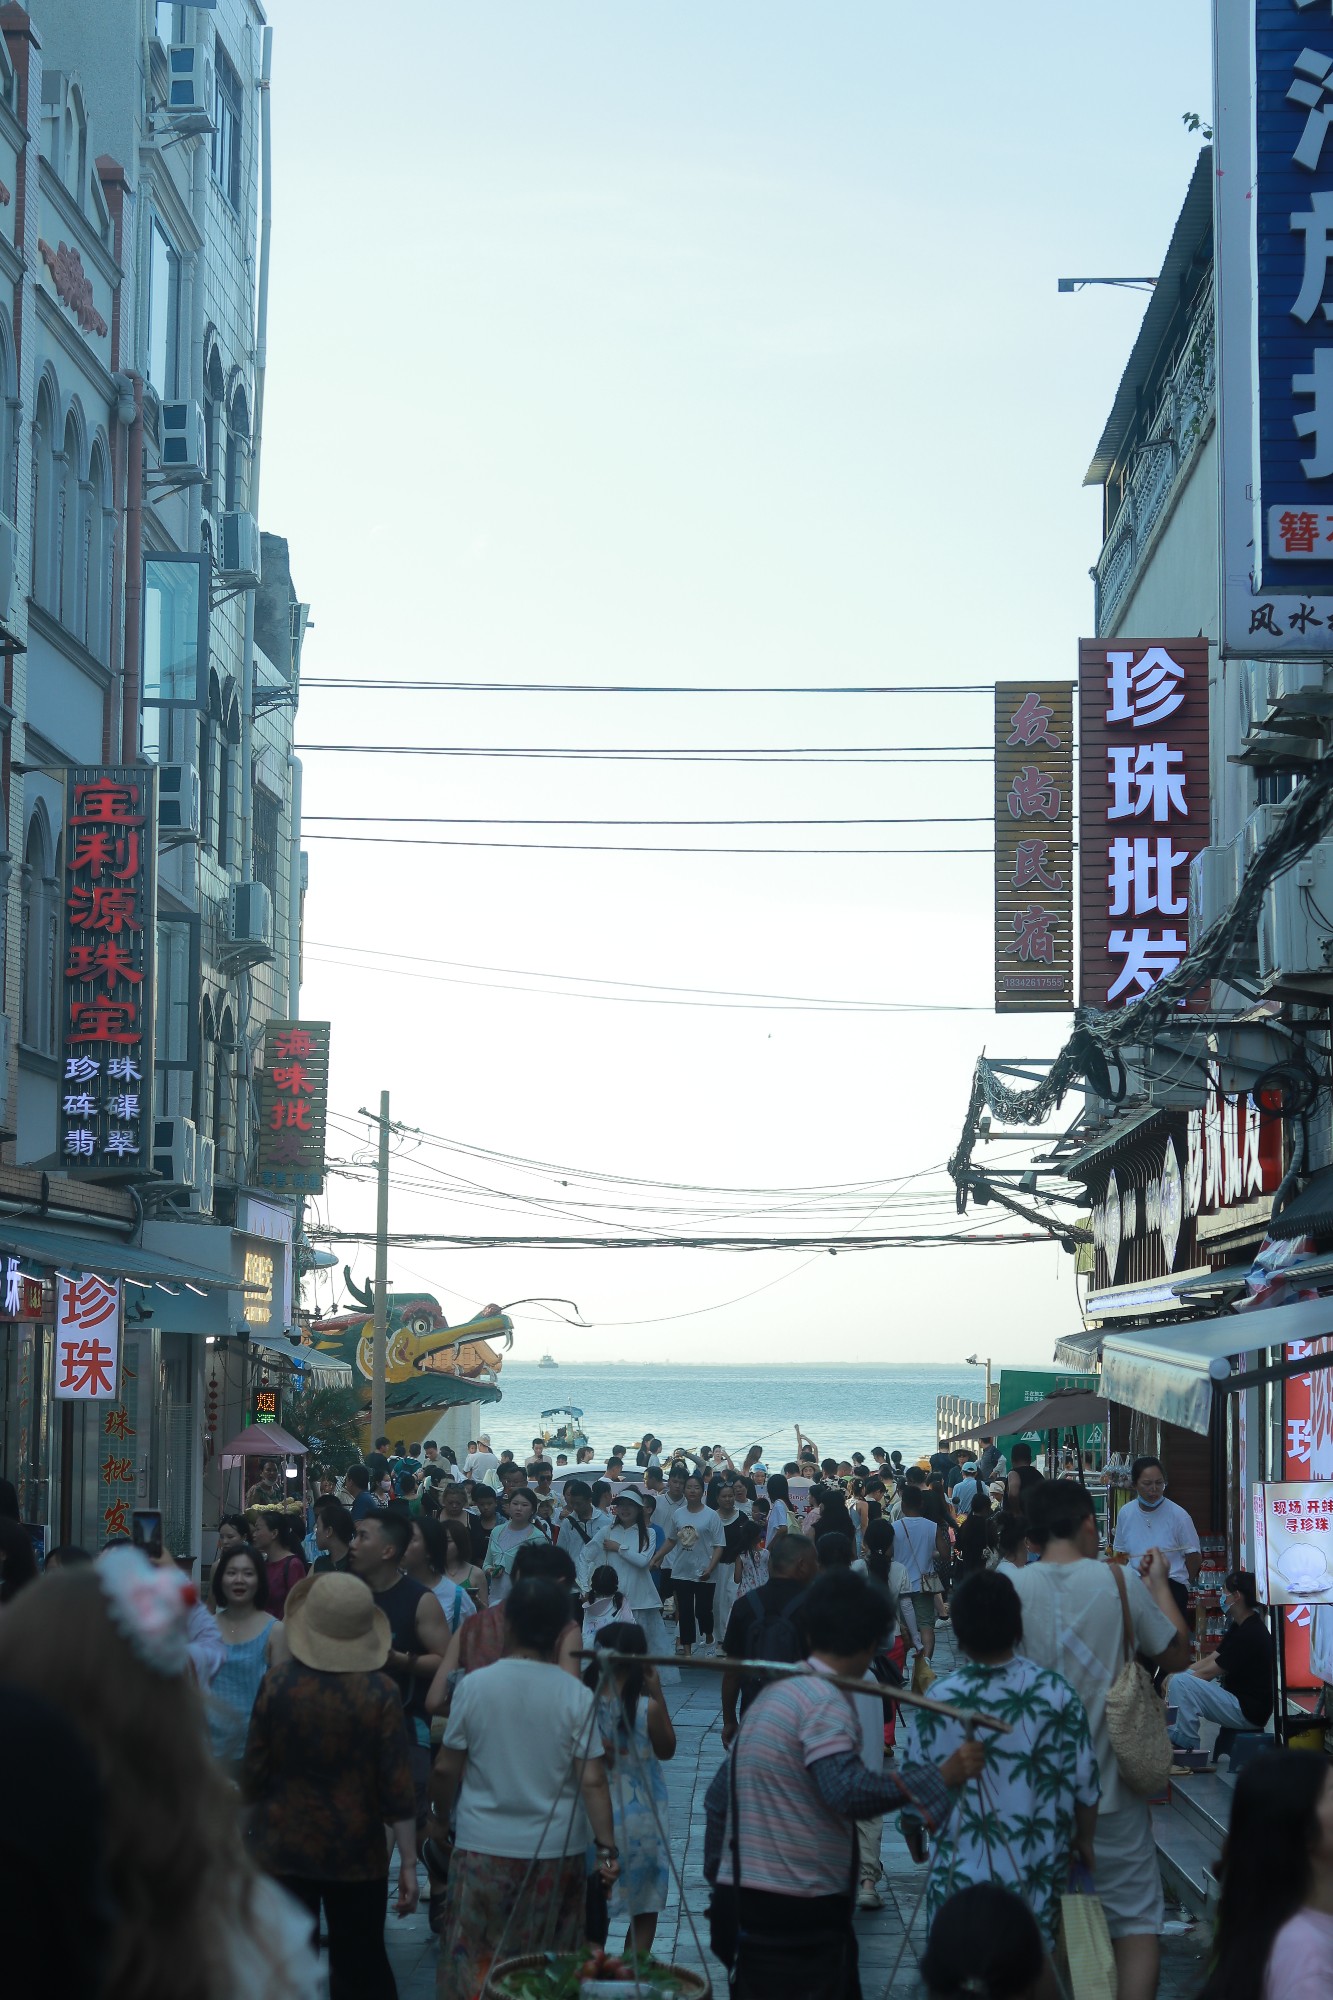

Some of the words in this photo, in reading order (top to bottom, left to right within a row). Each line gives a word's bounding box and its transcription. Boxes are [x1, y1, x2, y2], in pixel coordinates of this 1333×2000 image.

[1279, 511, 1333, 553] 簪
[1248, 602, 1333, 637] 风水
[1105, 647, 1188, 1006] 珍珠批发
[66, 776, 146, 1045] 宝利源珠宝
[1005, 978, 1063, 987] 18342617555
[64, 1054, 142, 1083] 珍珠
[63, 1092, 142, 1121] 砗磲
[268, 1028, 317, 1166] 海味批发
[64, 1129, 140, 1158] 翡翠
[60, 1275, 118, 1396] 珍珠
[1273, 1500, 1302, 1515] 现场
[1286, 1517, 1330, 1533] 寻珍珠
